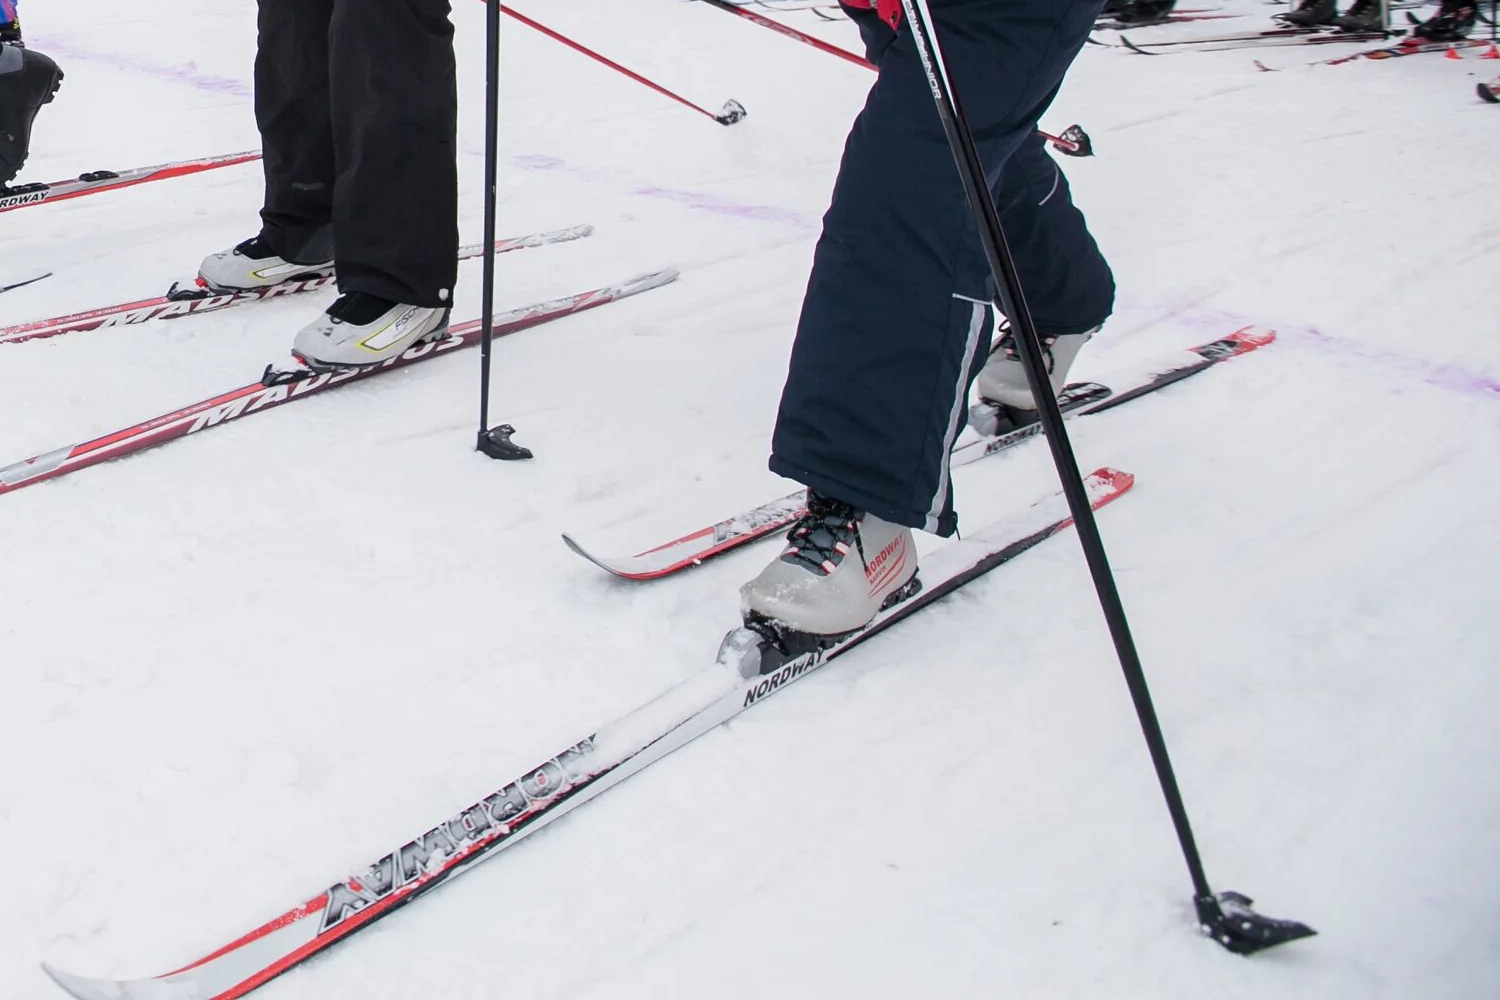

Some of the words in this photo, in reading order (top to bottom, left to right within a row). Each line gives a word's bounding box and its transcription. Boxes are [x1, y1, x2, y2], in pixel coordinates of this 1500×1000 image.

[100, 277, 336, 329] MADSHU
[984, 422, 1046, 455] NORDWA
[865, 534, 905, 579] NORDWAY
[743, 650, 826, 708] NORDWAY
